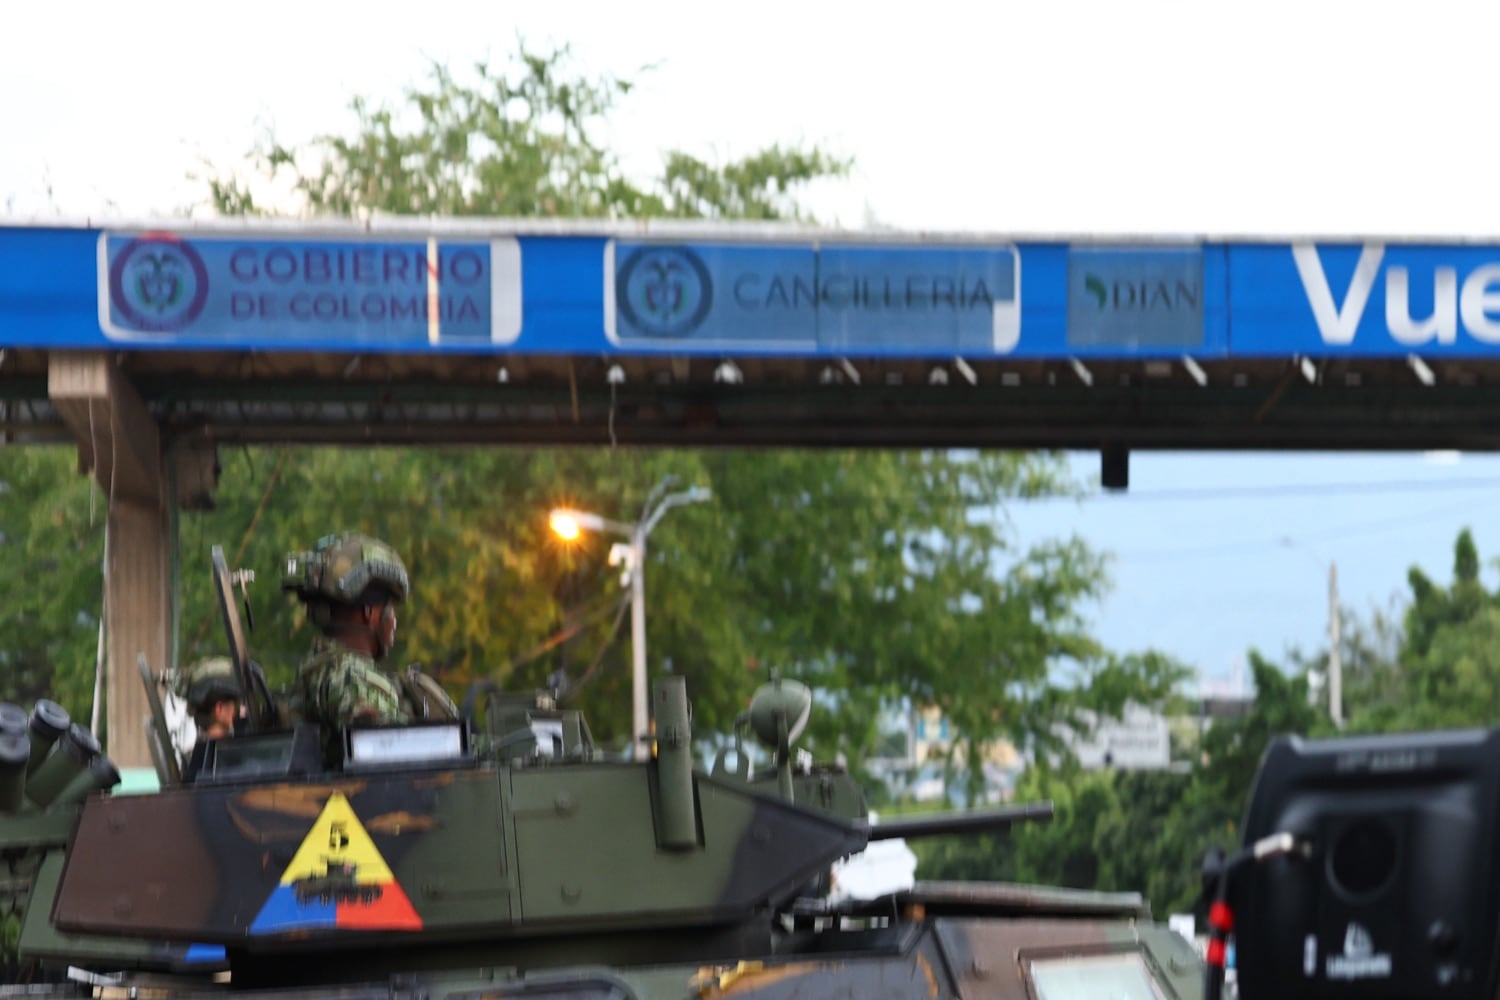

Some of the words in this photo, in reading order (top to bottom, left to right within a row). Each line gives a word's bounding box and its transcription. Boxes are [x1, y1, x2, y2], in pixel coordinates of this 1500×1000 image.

[229, 247, 484, 287] GOBIERNO
[231, 291, 277, 321] DE
[289, 291, 481, 323] COLOMBIA
[1113, 279, 1198, 311] DIAN
